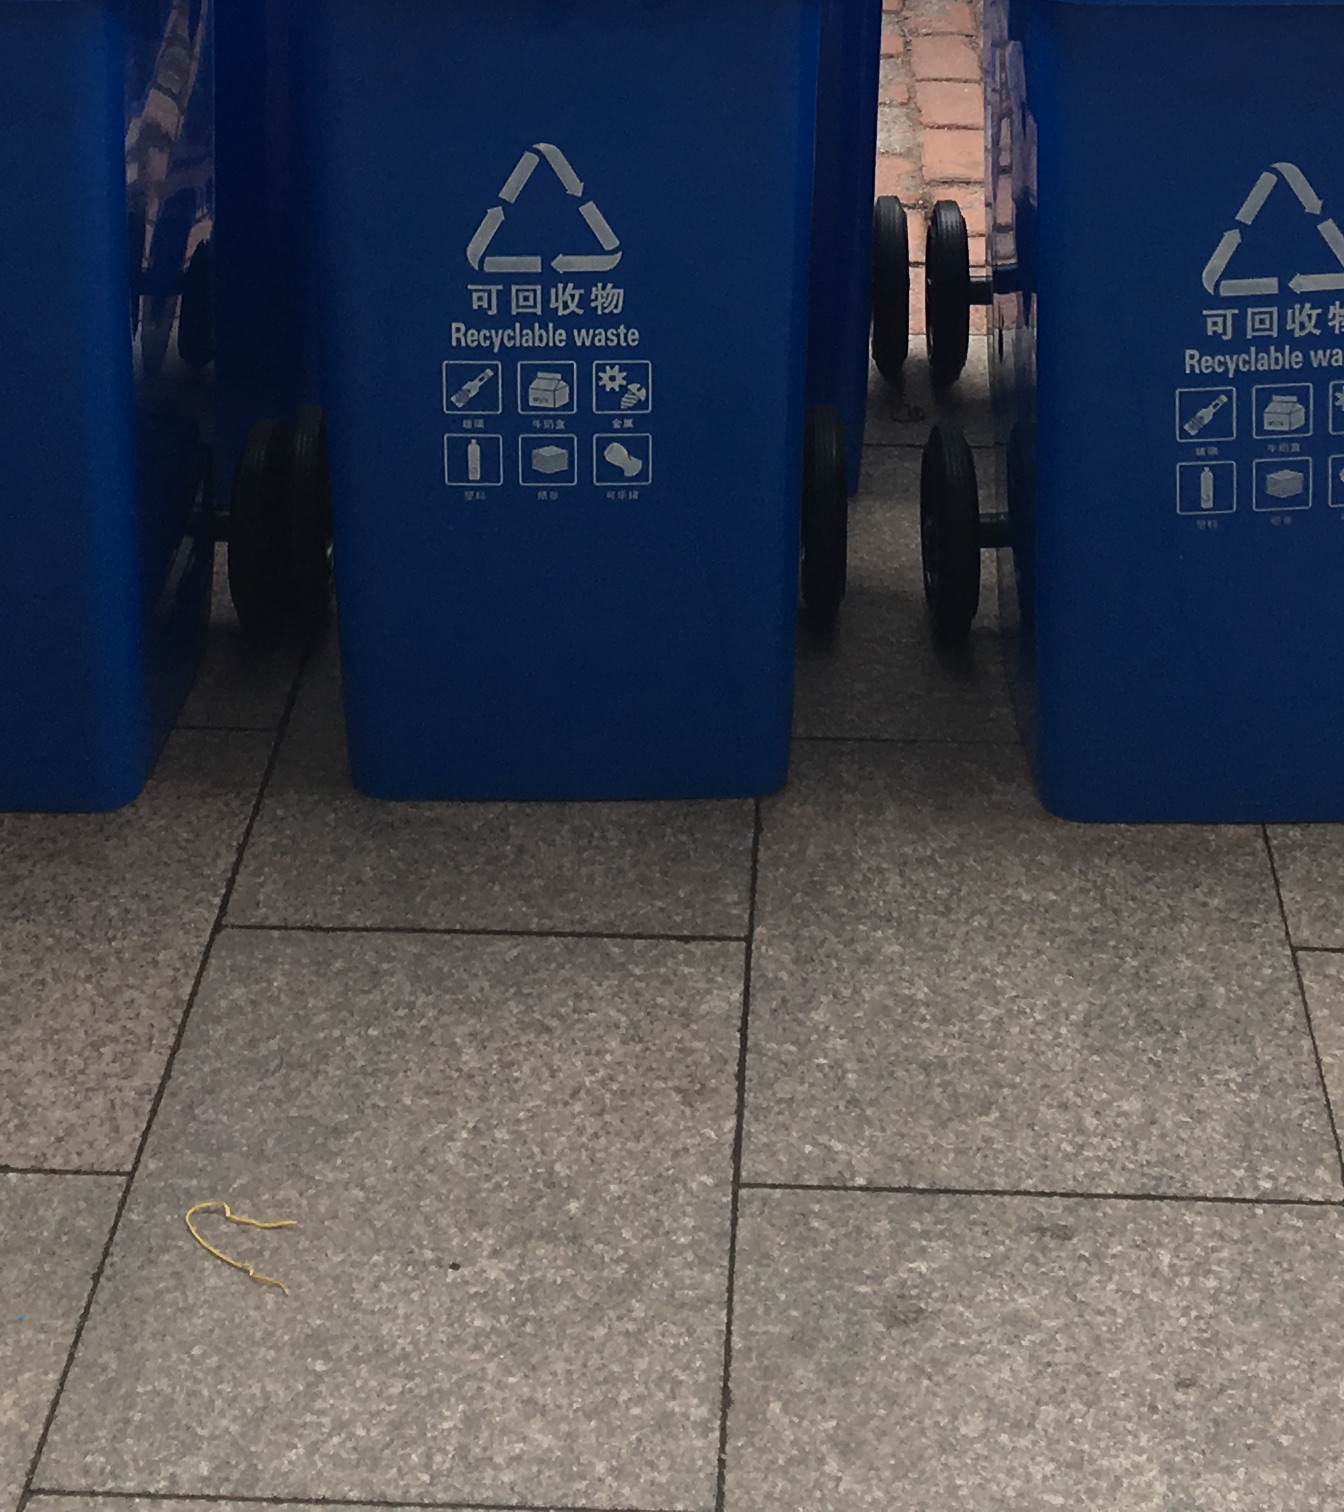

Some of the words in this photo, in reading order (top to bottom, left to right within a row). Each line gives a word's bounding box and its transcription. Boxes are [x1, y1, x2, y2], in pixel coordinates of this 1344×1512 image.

[467, 282, 625, 316] 可回收物
[450, 322, 567, 353] Recyclable
[573, 324, 640, 347] waste
[1184, 344, 1304, 378] Recyclable
